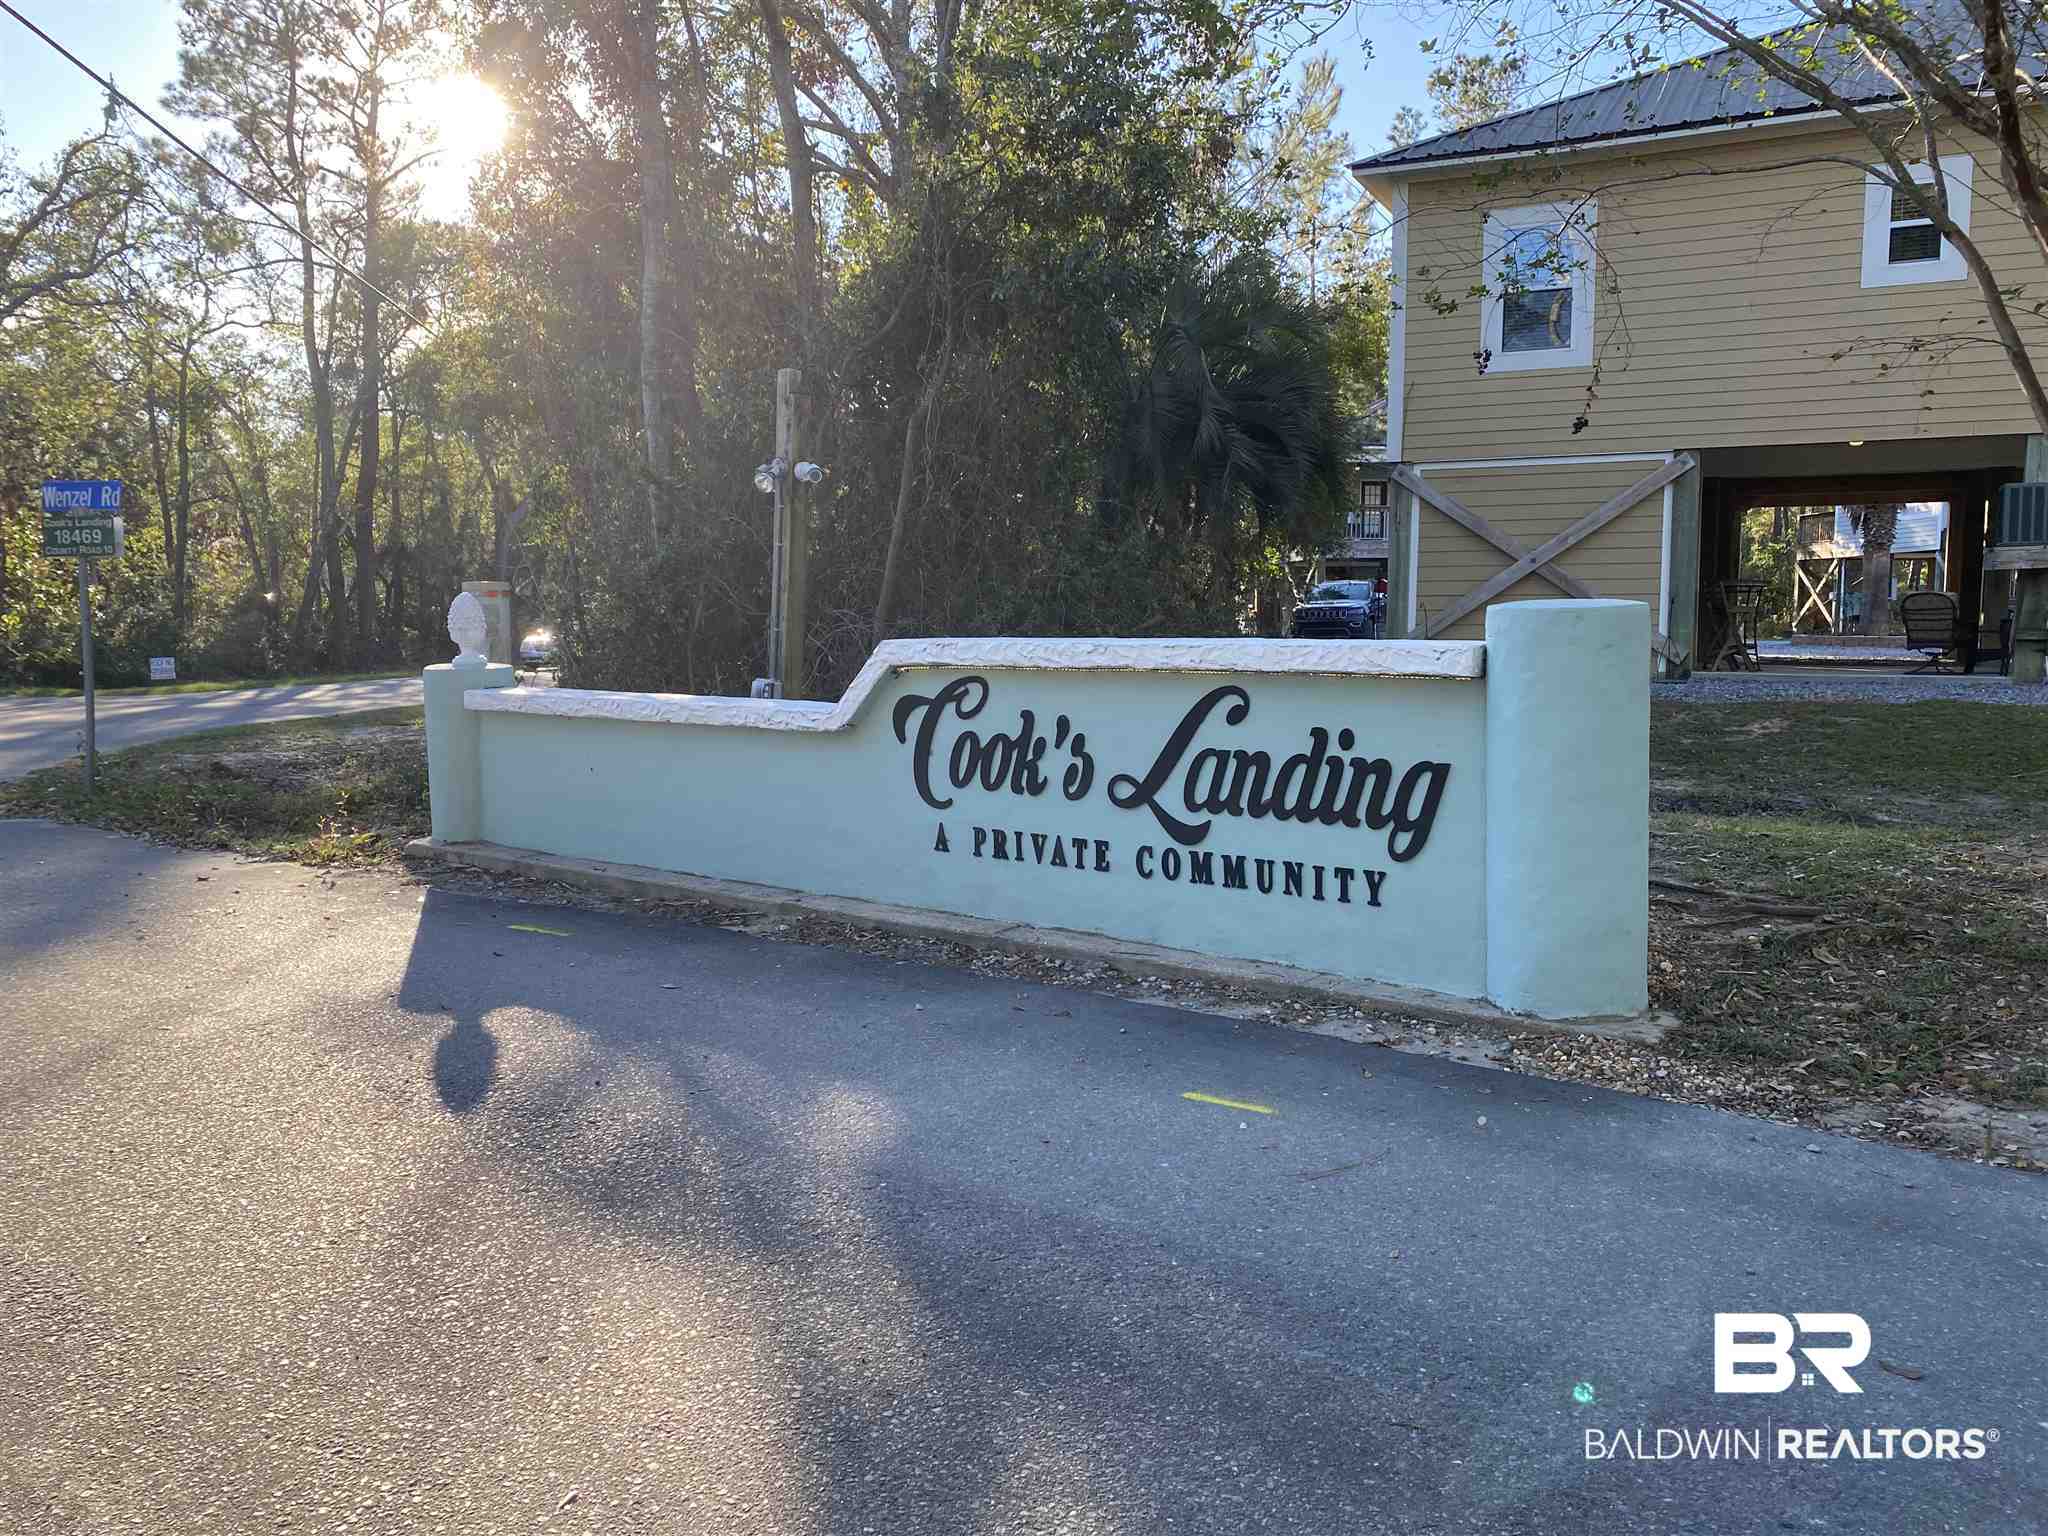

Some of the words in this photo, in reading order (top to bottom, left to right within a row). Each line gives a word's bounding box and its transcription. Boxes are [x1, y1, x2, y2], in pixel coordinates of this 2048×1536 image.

[43, 486, 91, 508] Wenzel
[101, 486, 121, 507] Rd
[54, 529, 102, 544] 18469
[893, 675, 1095, 810] Cook's
[1107, 685, 1452, 863] Landing
[934, 822, 951, 853] A
[972, 826, 1111, 873] PRIVATE
[1135, 844, 1387, 908] COMMUNITY
